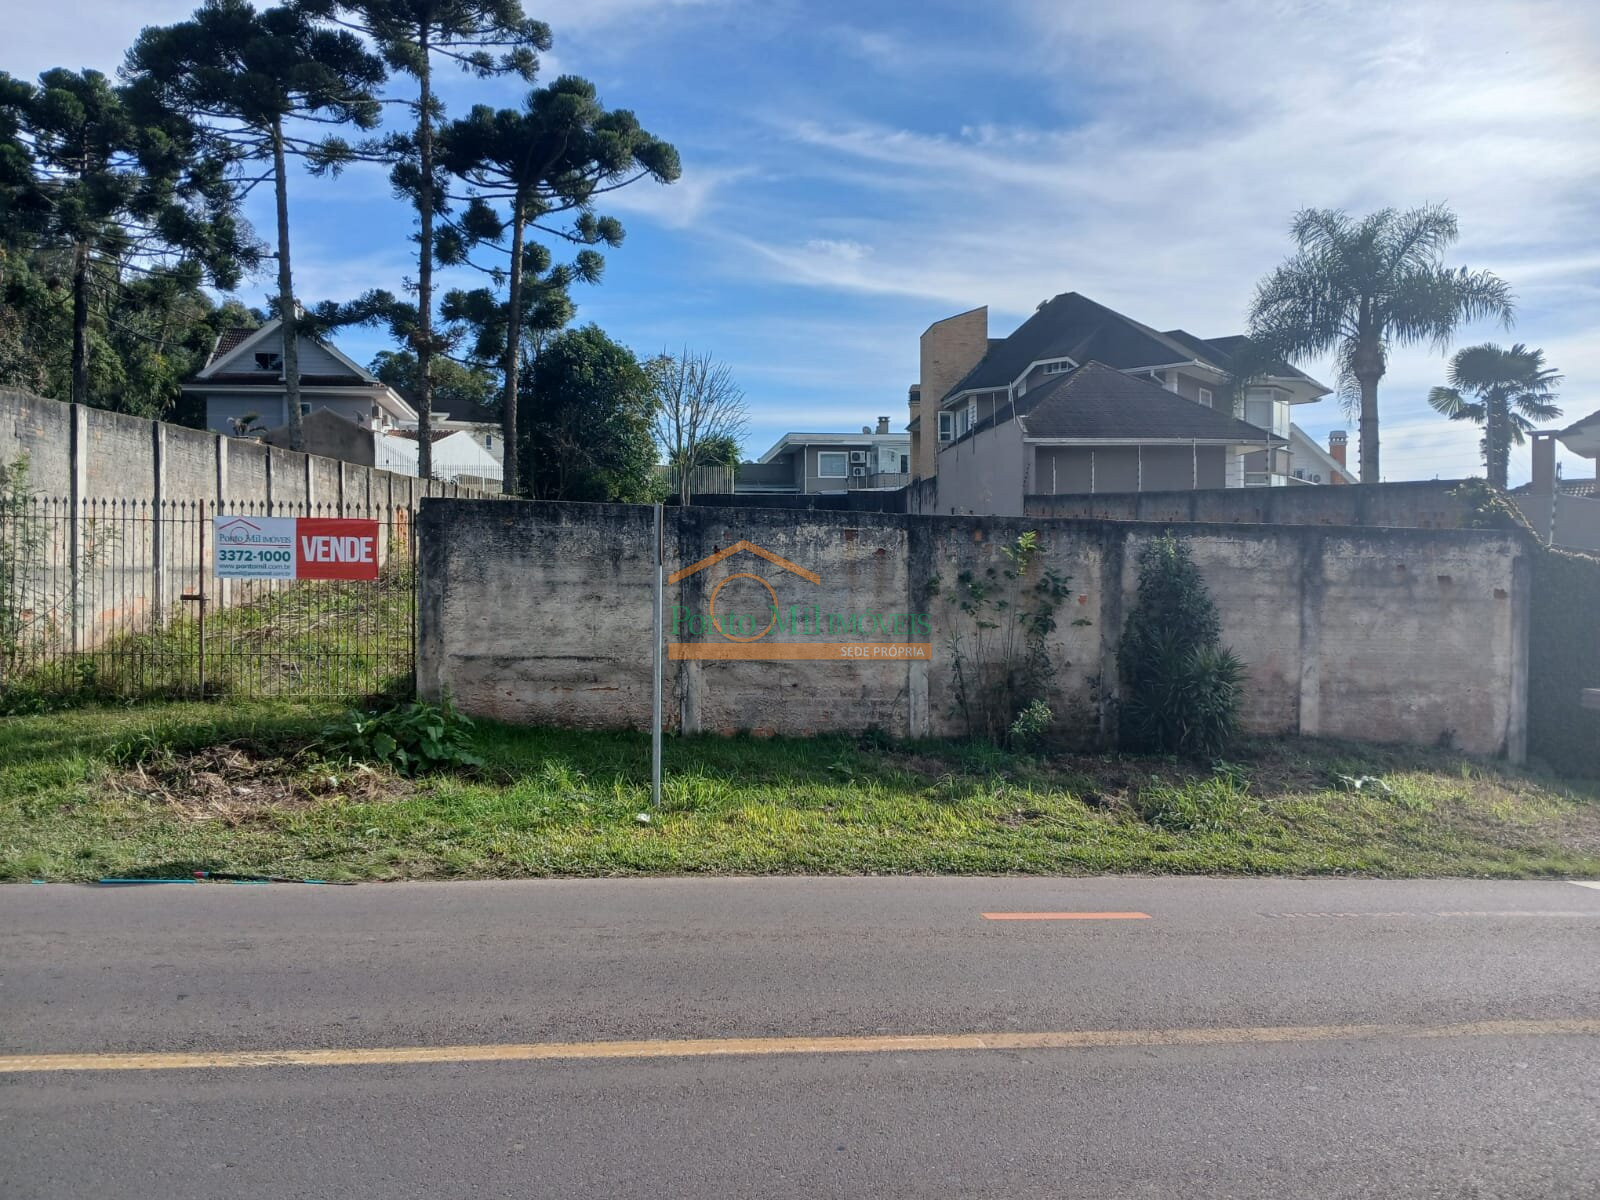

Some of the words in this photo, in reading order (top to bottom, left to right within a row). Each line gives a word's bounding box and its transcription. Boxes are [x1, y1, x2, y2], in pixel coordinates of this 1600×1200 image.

[219, 534, 243, 543] Ponto
[245, 533, 261, 543] Mil
[302, 536, 373, 562] VENDE
[219, 550, 291, 562] 3372-1000
